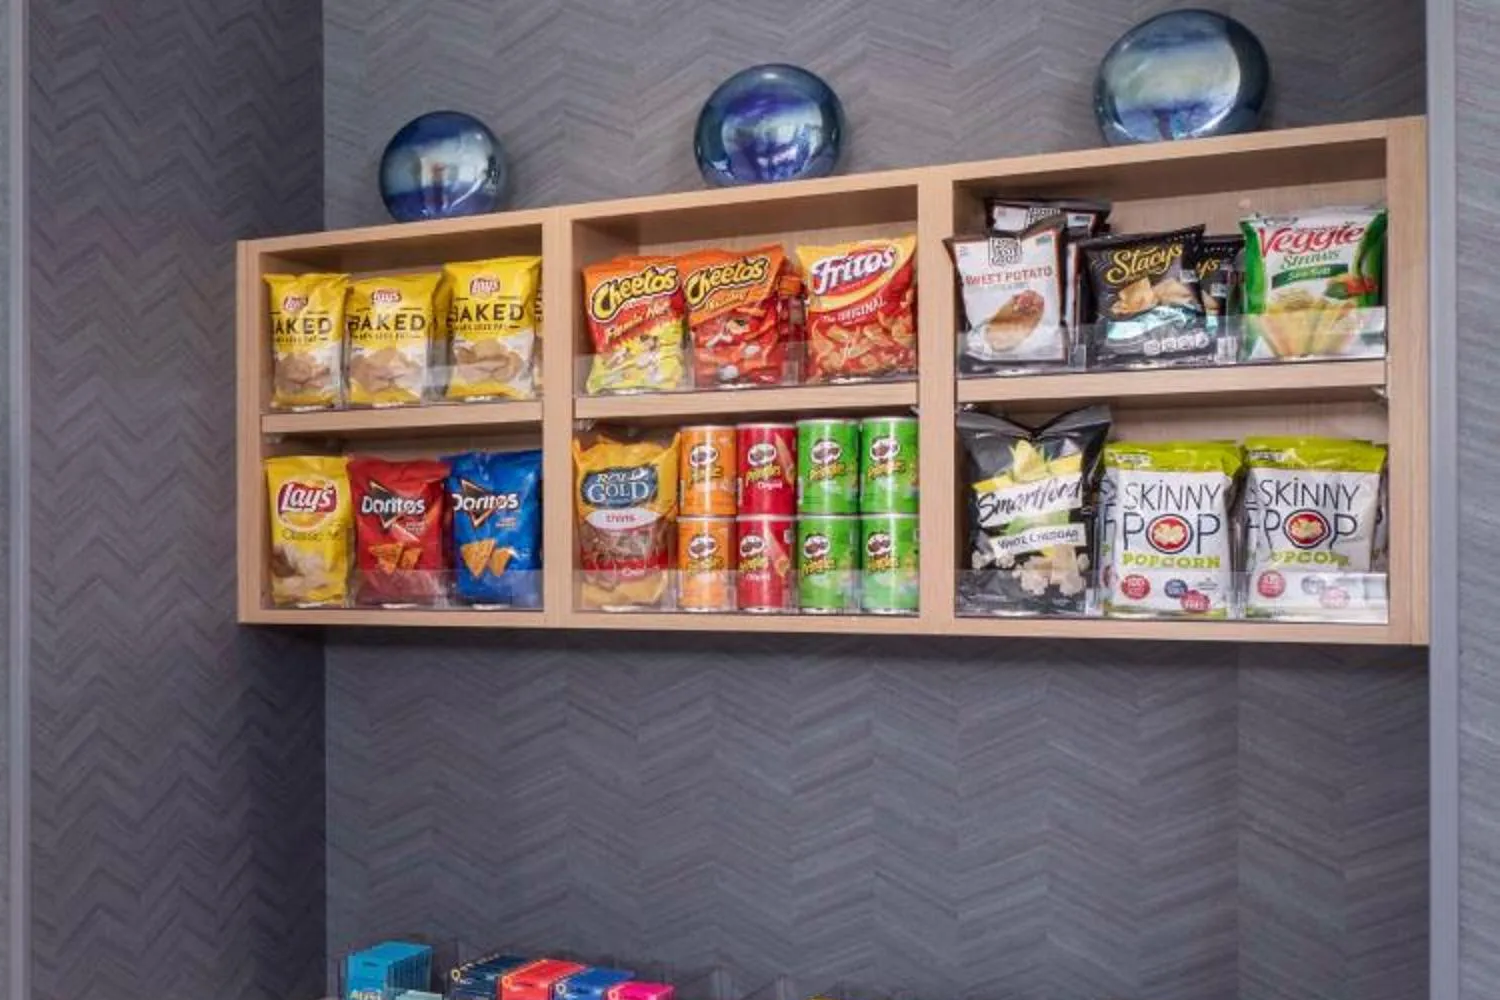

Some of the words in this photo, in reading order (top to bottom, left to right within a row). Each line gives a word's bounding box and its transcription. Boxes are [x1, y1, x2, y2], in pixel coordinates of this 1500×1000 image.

[1257, 223, 1365, 258] Veggie
[686, 256, 769, 308] Cheetos
[811, 247, 897, 294] Fritos
[1005, 266, 1053, 281] POTATO
[592, 264, 679, 321] Cheetos
[280, 482, 337, 513] Lay's
[361, 494, 426, 515] Doritos
[587, 481, 649, 503] GOLD
[976, 477, 1083, 523] Smartfood
[1123, 512, 1221, 554] POP
[1263, 508, 1359, 550] POP
[1122, 554, 1221, 569] POPCORN
